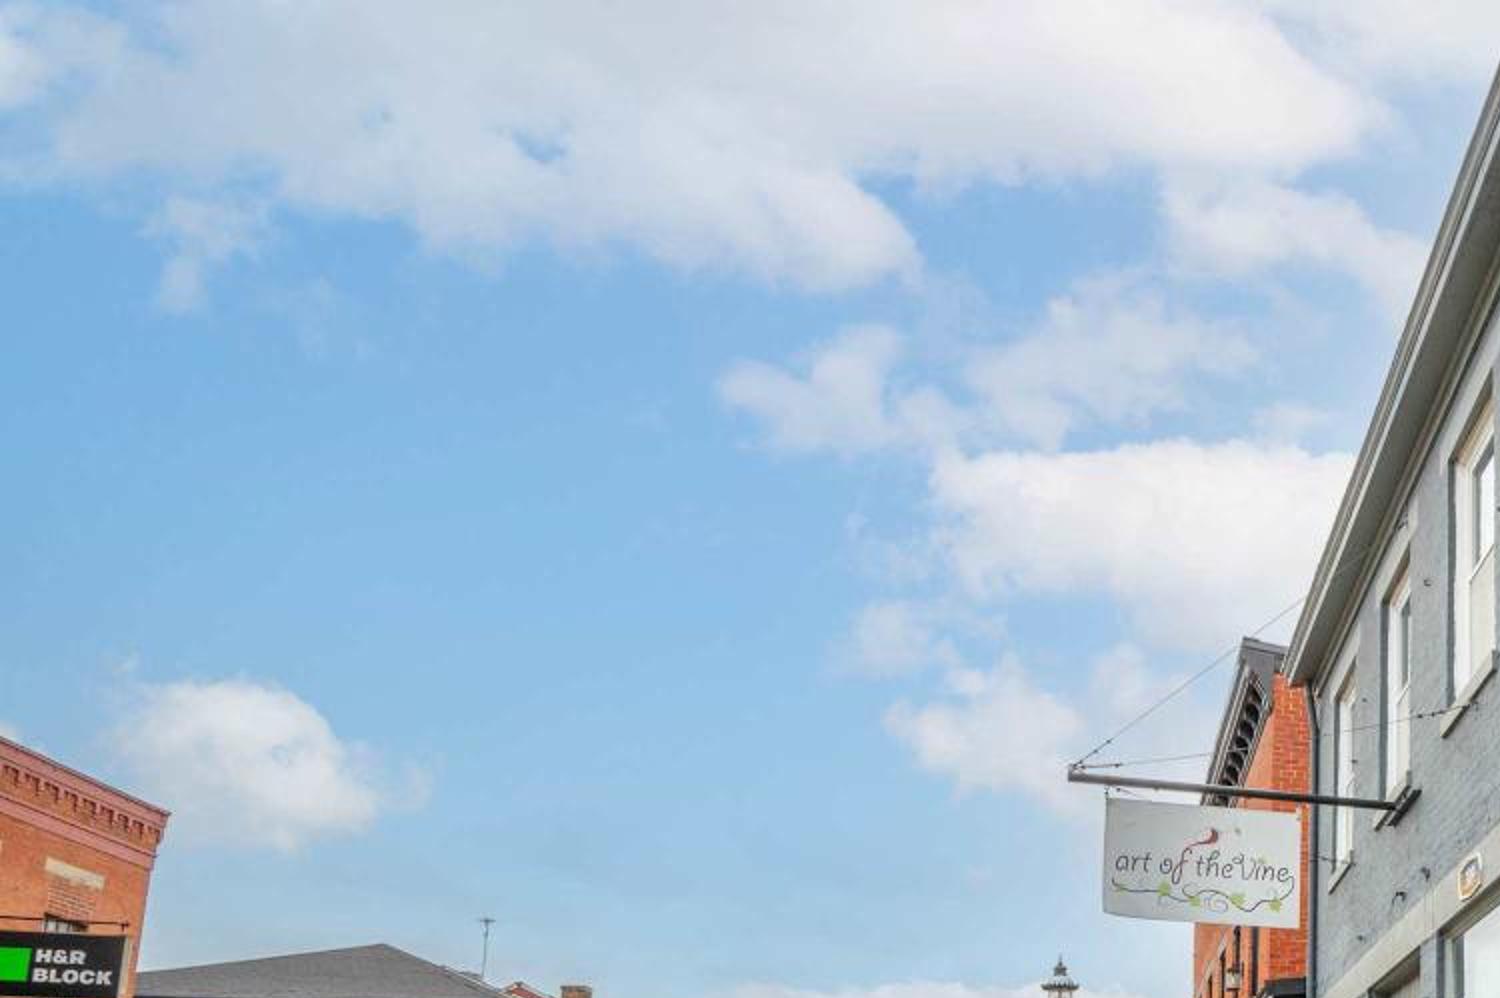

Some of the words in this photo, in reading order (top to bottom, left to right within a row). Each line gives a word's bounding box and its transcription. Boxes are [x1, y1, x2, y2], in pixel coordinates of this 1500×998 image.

[1114, 851, 1152, 873] art
[1159, 847, 1193, 885] of
[1195, 850, 1232, 879] the
[34, 948, 87, 965] H&R
[31, 967, 113, 985] BLOCK
